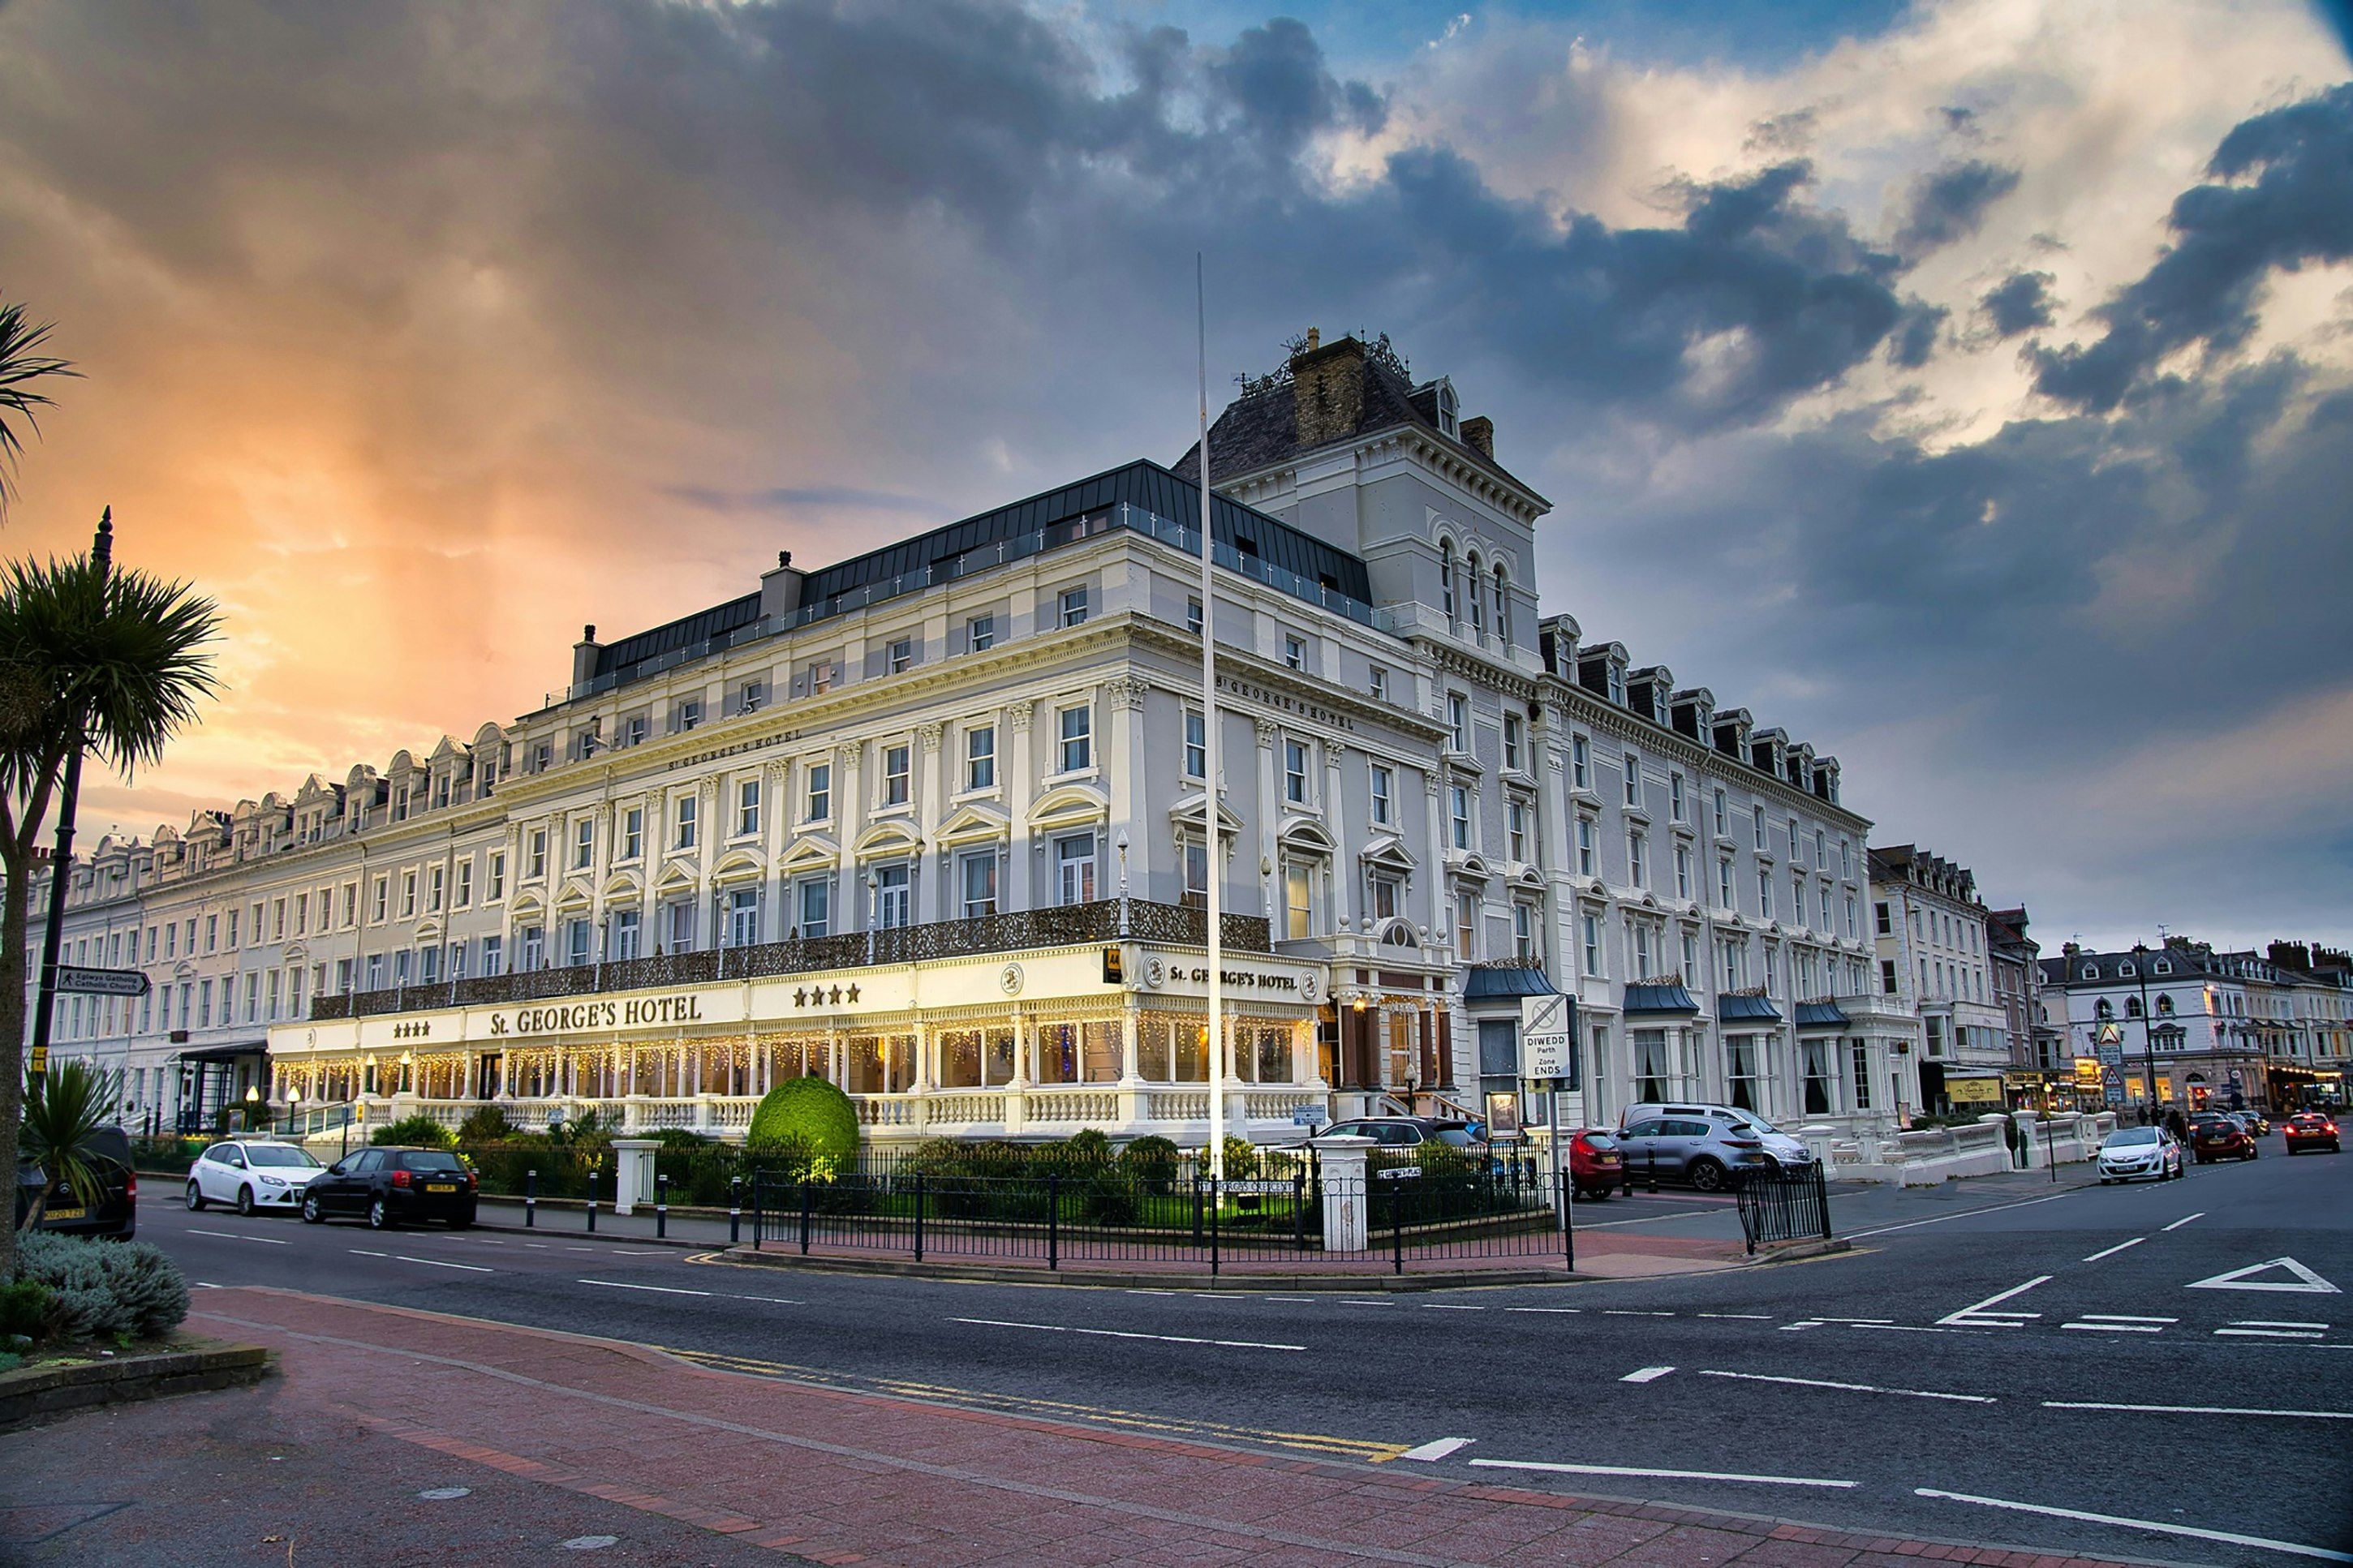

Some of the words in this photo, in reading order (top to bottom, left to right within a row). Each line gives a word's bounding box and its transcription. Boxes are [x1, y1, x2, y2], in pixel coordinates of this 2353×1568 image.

[1231, 681, 1305, 714] GEORGE'S
[1310, 707, 1354, 730] HOTEL
[683, 741, 748, 767] GEORGE'S
[755, 730, 802, 750] HOTEL
[76, 973, 103, 981] Eglwys
[105, 974, 137, 983] Gatholig
[1170, 966, 1187, 981] St.
[1191, 969, 1254, 986] GERGE'S
[1258, 975, 1297, 990] HOTEL
[110, 982, 137, 990] Church
[490, 1013, 509, 1034] St.
[518, 1001, 616, 1033] GEORGE'S
[624, 995, 702, 1025] HOTEL
[1527, 1036, 1565, 1046] DIWEDD
[1537, 1046, 1556, 1055] Parth
[1538, 1058, 1555, 1066] Zone
[1534, 1065, 1561, 1076] ENDS
